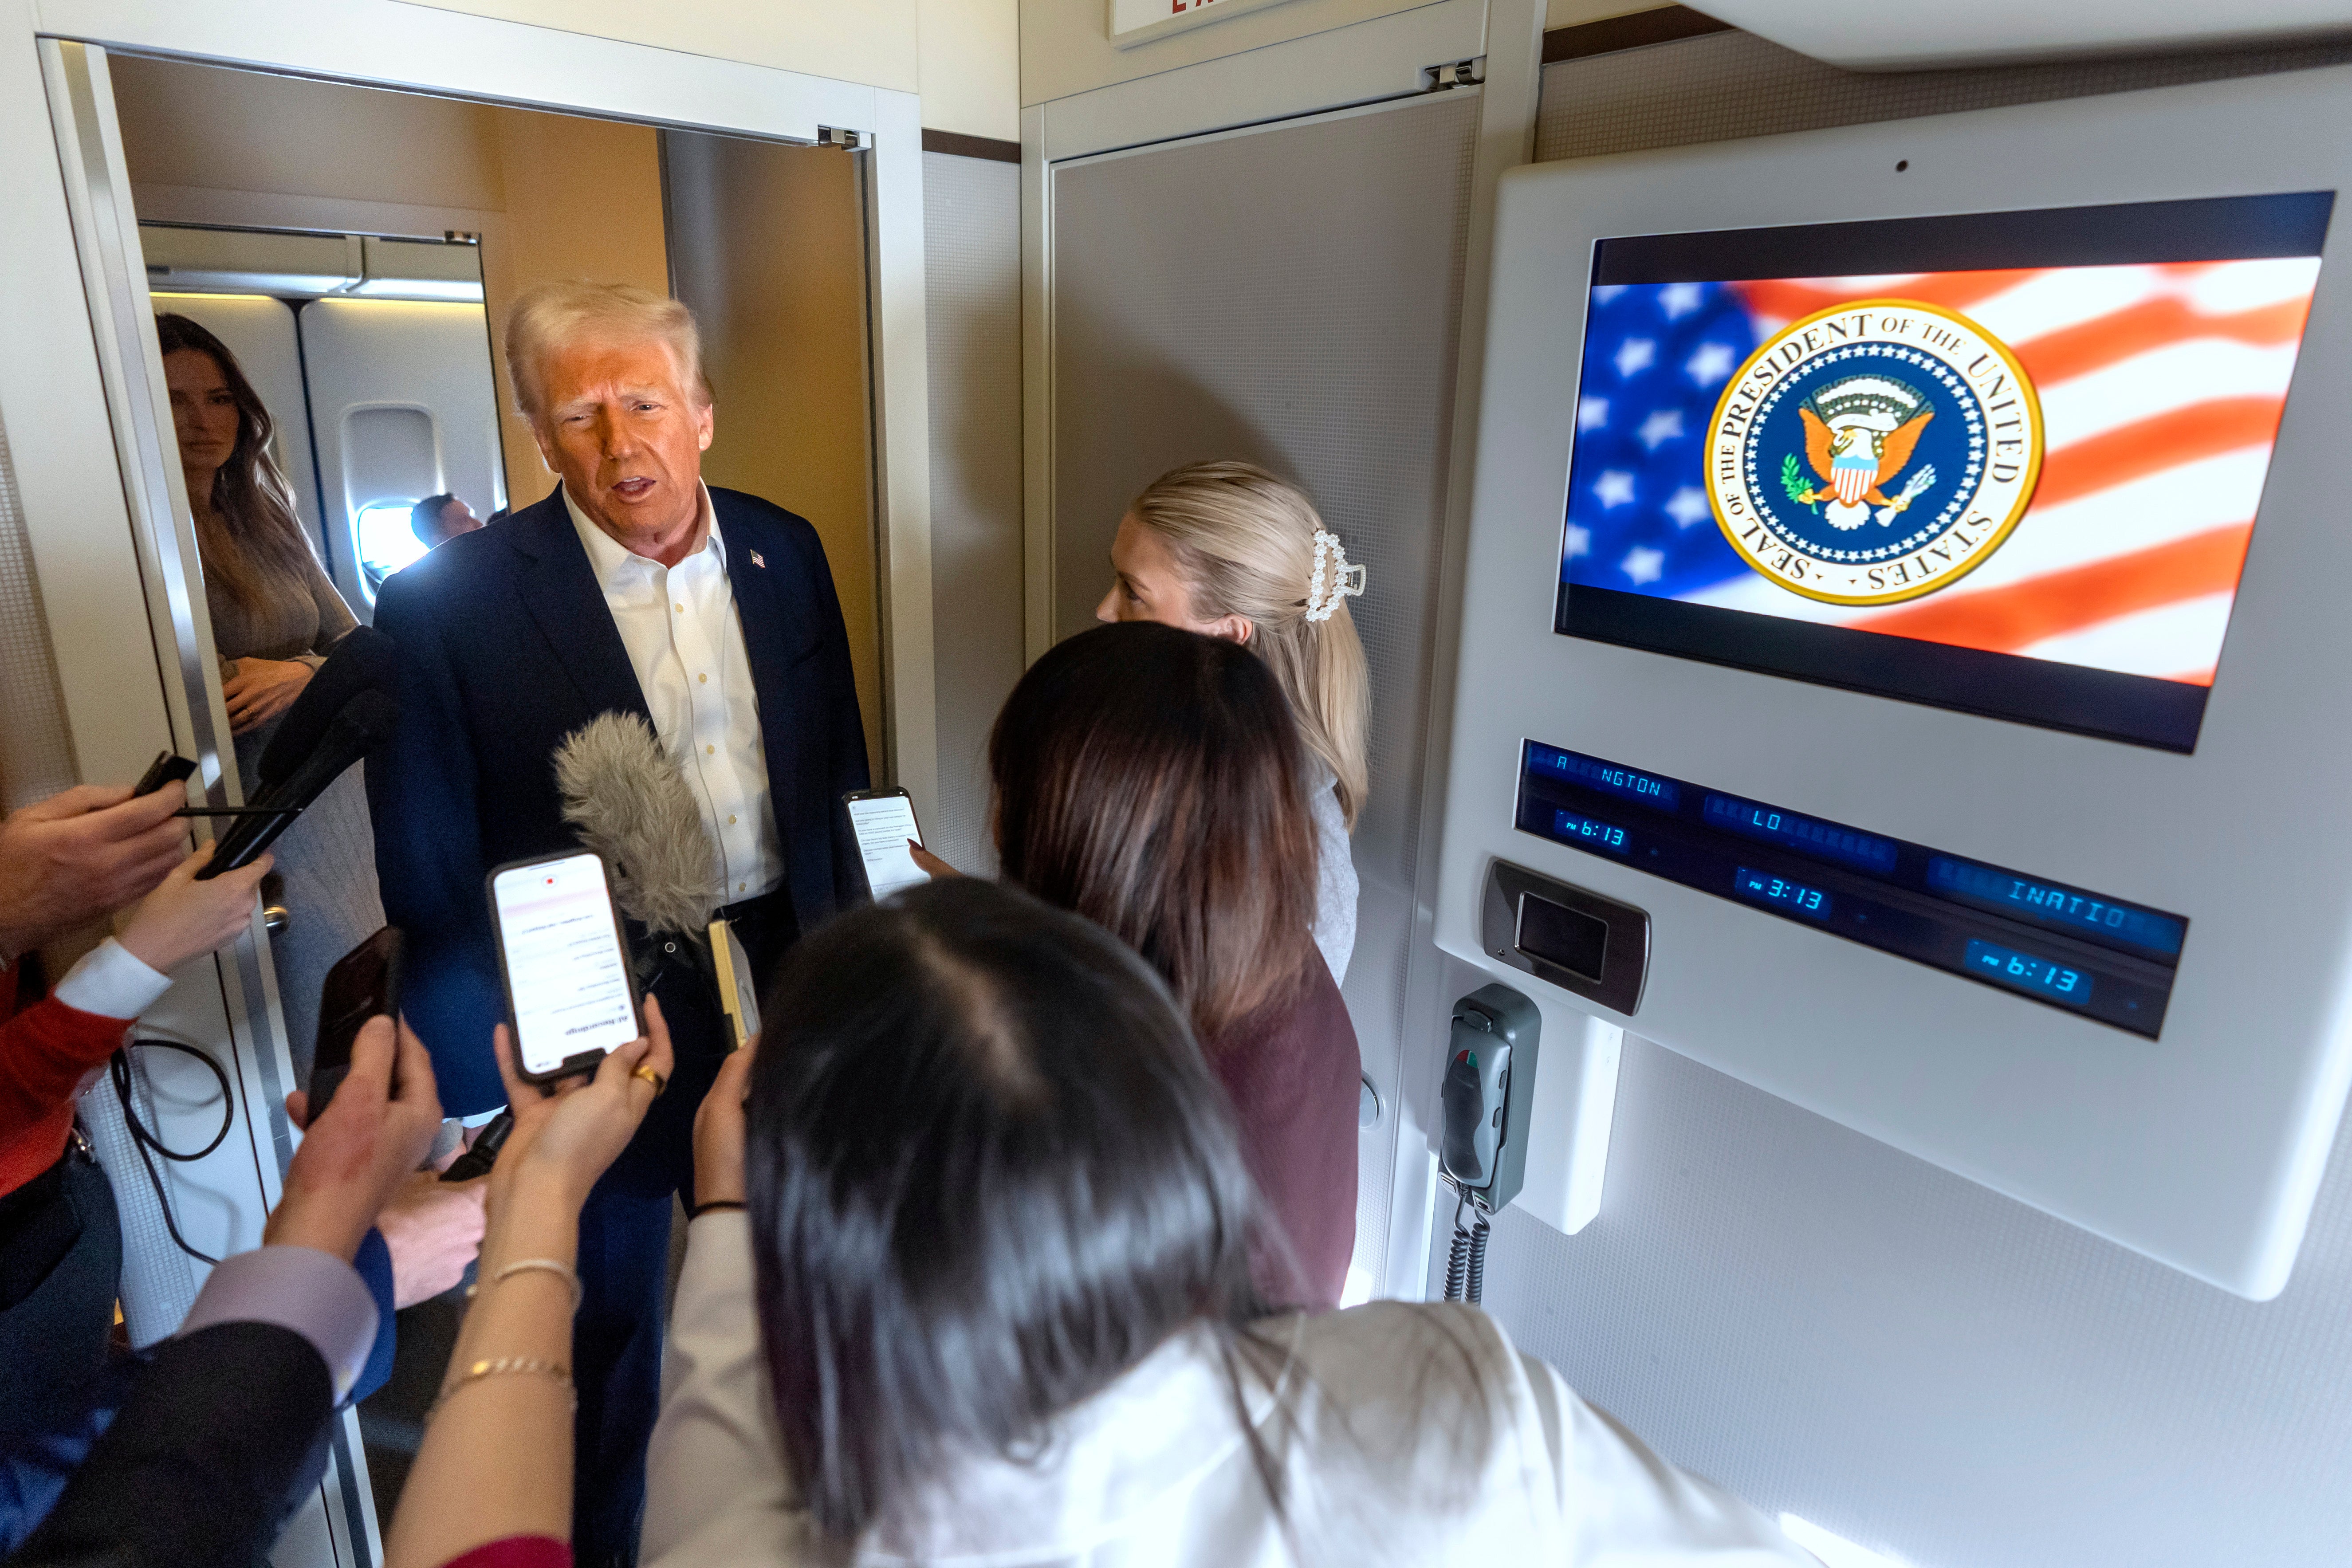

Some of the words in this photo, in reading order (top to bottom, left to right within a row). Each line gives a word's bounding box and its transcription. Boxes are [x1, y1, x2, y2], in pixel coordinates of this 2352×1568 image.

[1881, 317, 1912, 334] OF
[1923, 323, 1968, 354] THE
[1722, 314, 1873, 438] PRESIDENT
[1968, 354, 2024, 483] UNITED
[1721, 445, 1735, 485] THE
[1727, 493, 1744, 516] OF
[1741, 518, 1811, 579] SEAL
[1868, 511, 1992, 589] STATES
[1581, 821, 1624, 846] 6:13
[1753, 810, 1781, 830] LO
[1749, 881, 1762, 891] PM
[1768, 879, 1822, 910] 3:13
[2008, 880, 2125, 928] INATIO
[2006, 955, 2078, 992] 6:13
